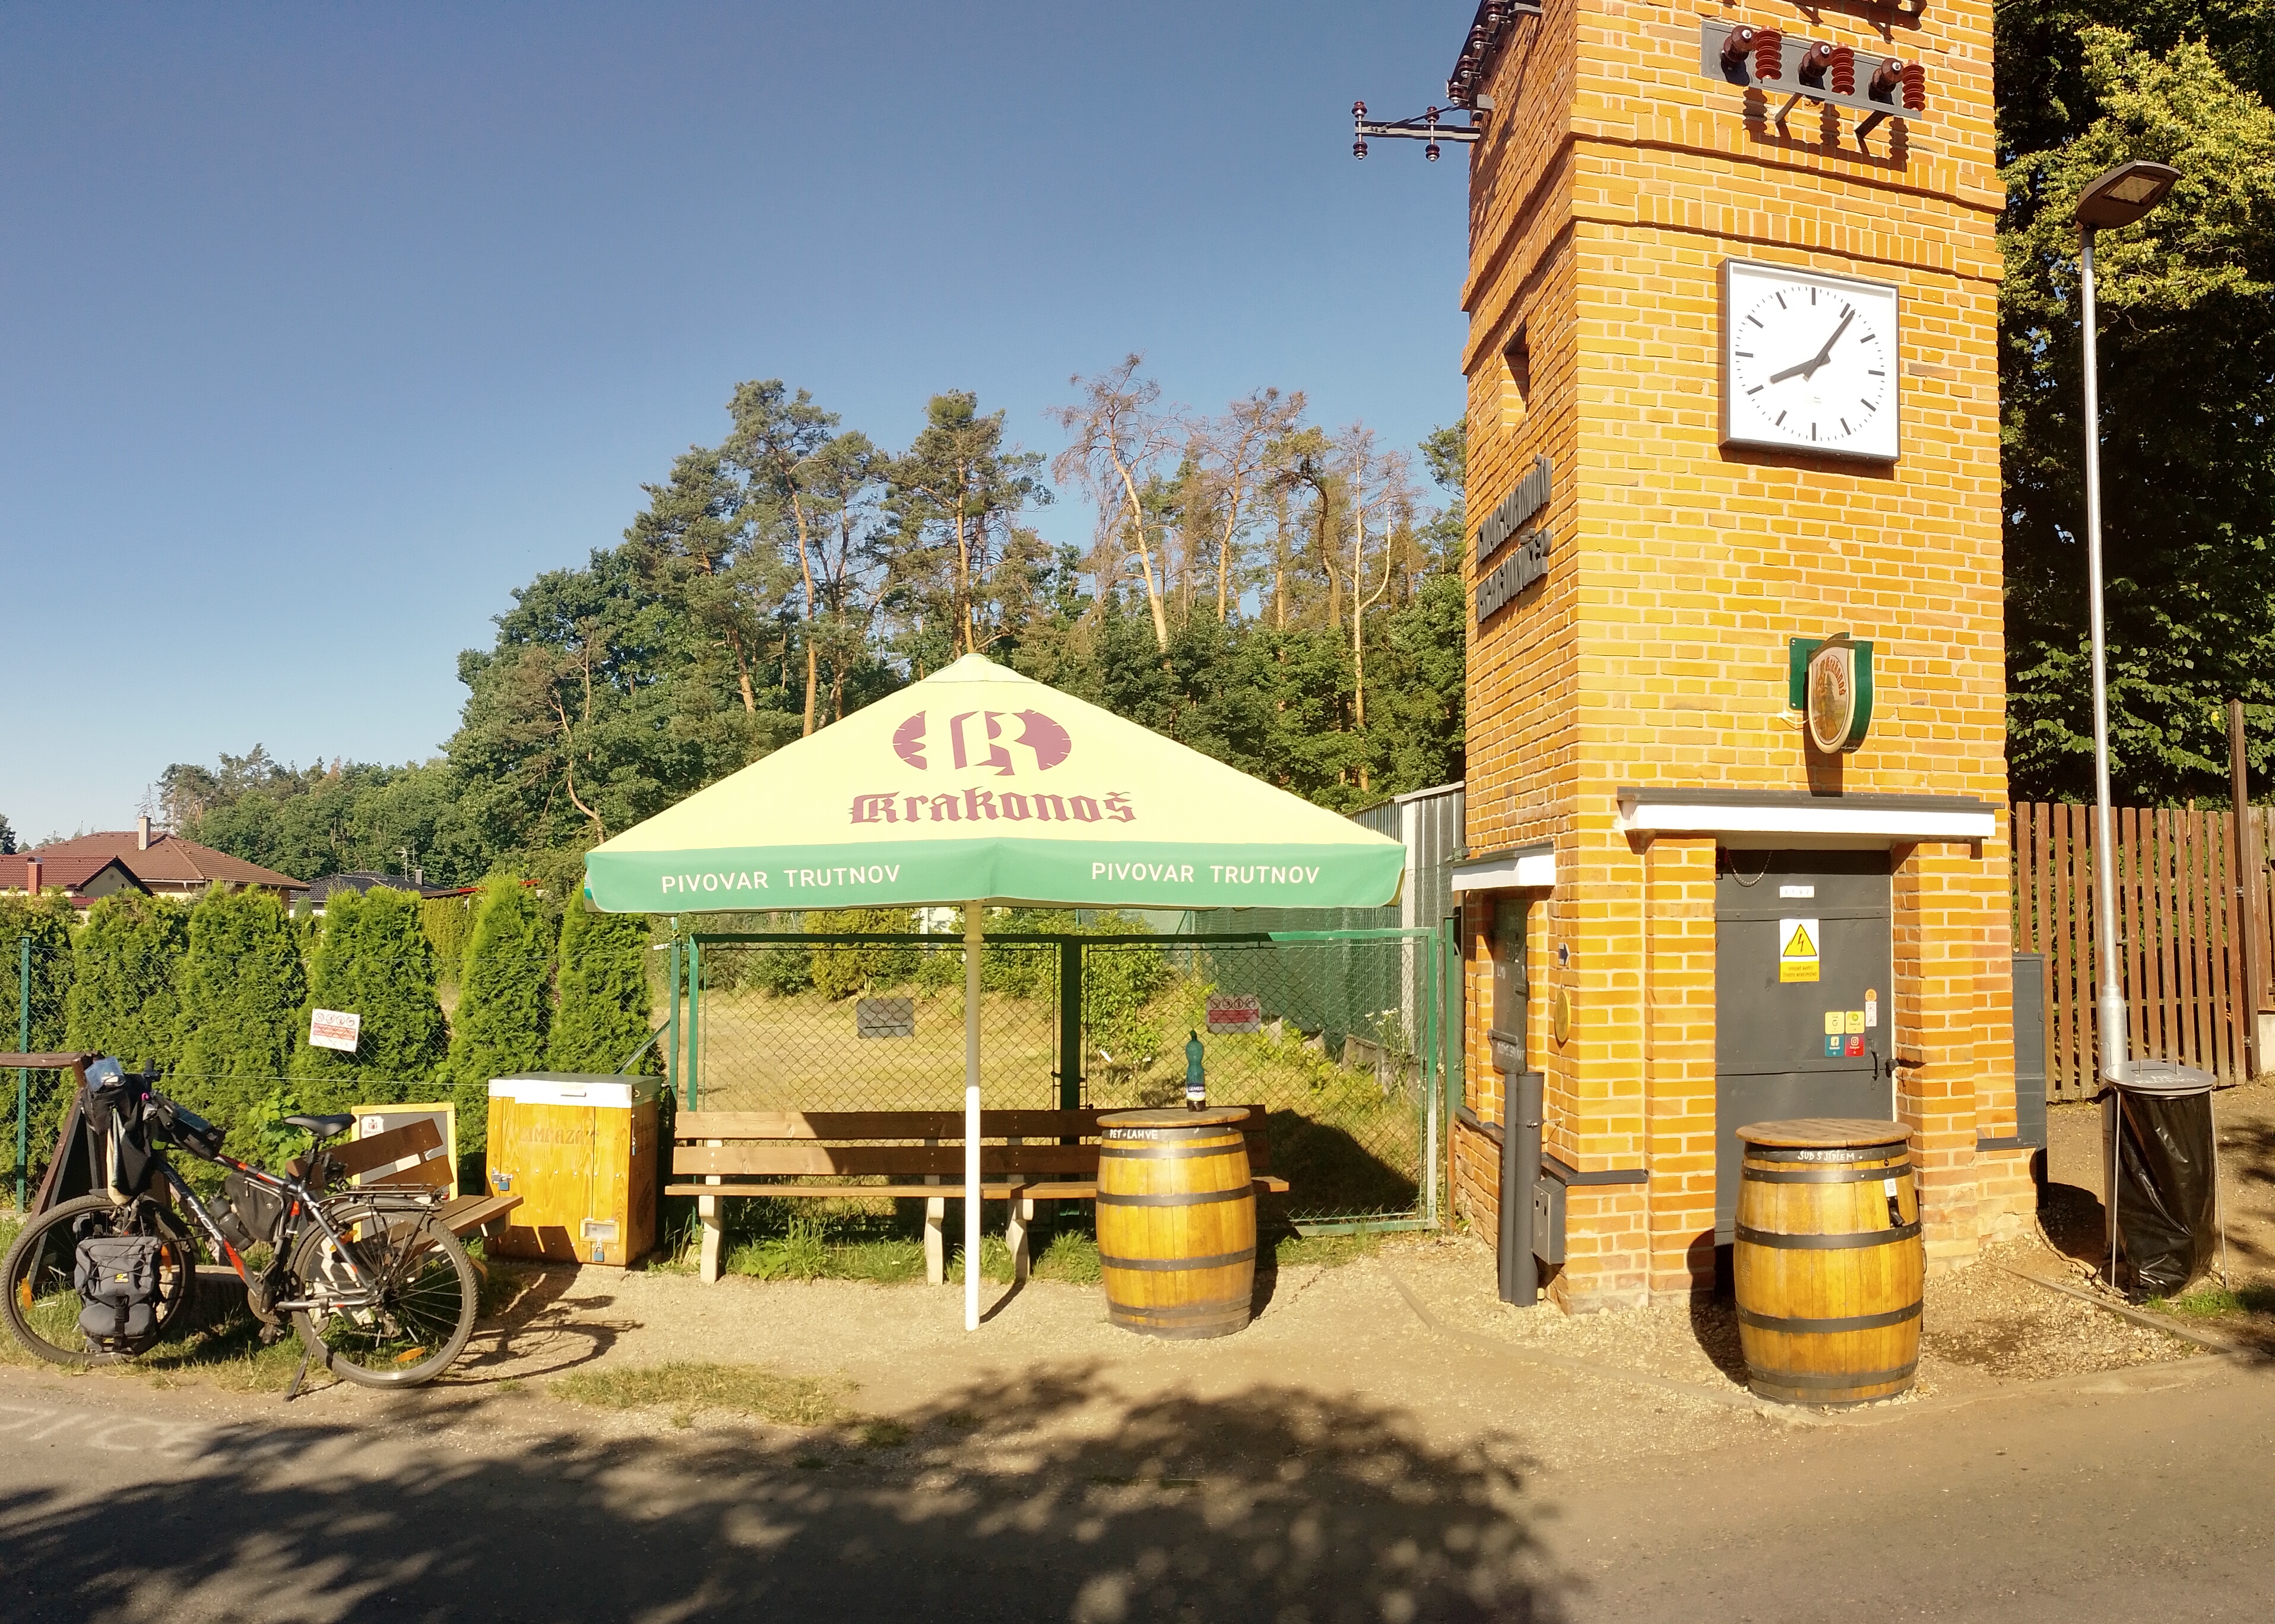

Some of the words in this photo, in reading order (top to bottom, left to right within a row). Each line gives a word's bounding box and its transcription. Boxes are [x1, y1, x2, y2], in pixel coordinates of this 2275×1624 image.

[850, 786, 1136, 824] Krakonoš
[661, 871, 768, 893] PIVOVAR
[783, 865, 899, 887] TRUTNOV
[1092, 862, 1194, 883] PIVOVAR
[1209, 865, 1320, 884] TRUTNOV
[1797, 1150, 1814, 1160] SUD
